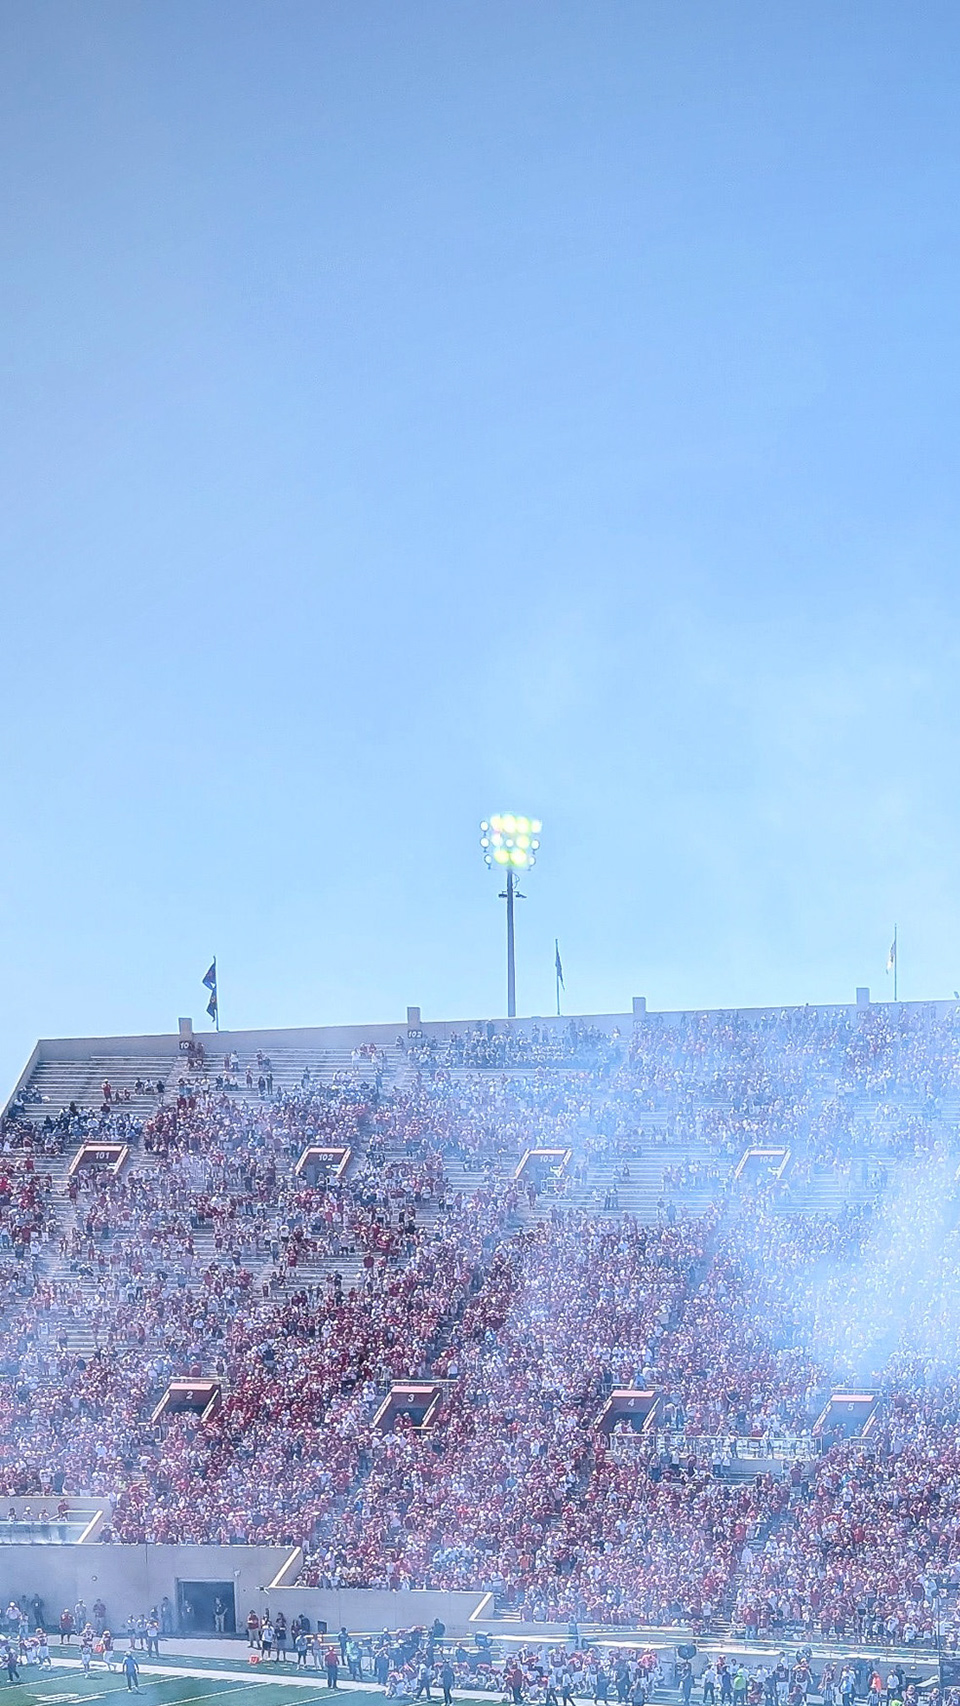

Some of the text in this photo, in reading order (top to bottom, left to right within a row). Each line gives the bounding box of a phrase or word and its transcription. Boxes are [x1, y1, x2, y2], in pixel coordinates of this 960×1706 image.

[95, 1151, 110, 1160] 101
[318, 1153, 334, 1162] 102
[539, 1155, 555, 1163] 103
[185, 1390, 194, 1400] 2
[407, 1393, 415, 1403] 3
[627, 1397, 635, 1407] 4
[847, 1402, 855, 1411] 5
